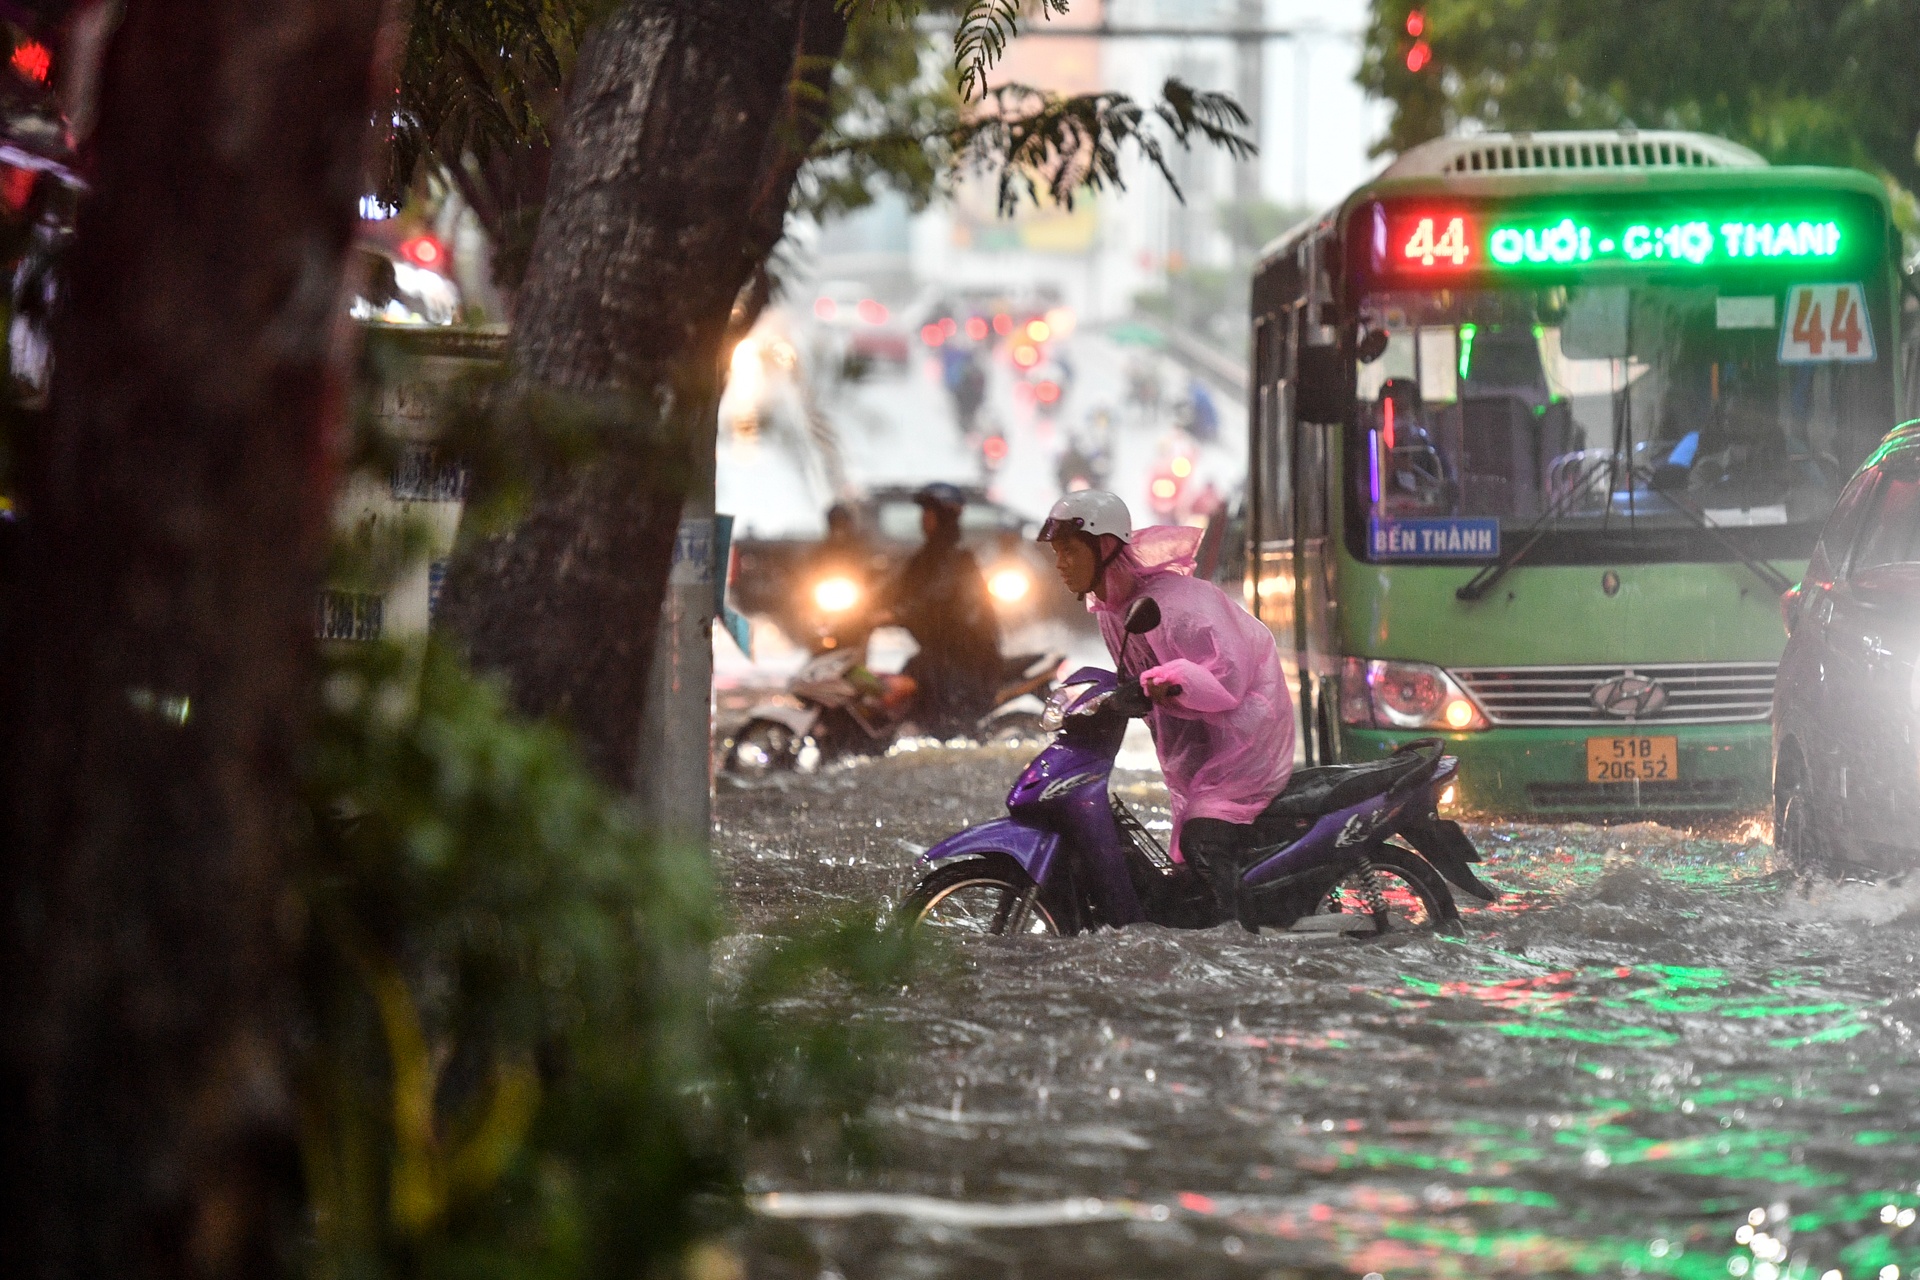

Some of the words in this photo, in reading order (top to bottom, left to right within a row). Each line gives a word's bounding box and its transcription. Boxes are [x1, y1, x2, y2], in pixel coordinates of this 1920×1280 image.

[1405, 218, 1469, 265] 44
[1793, 288, 1862, 355] 44
[1613, 739, 1651, 758] 51B
